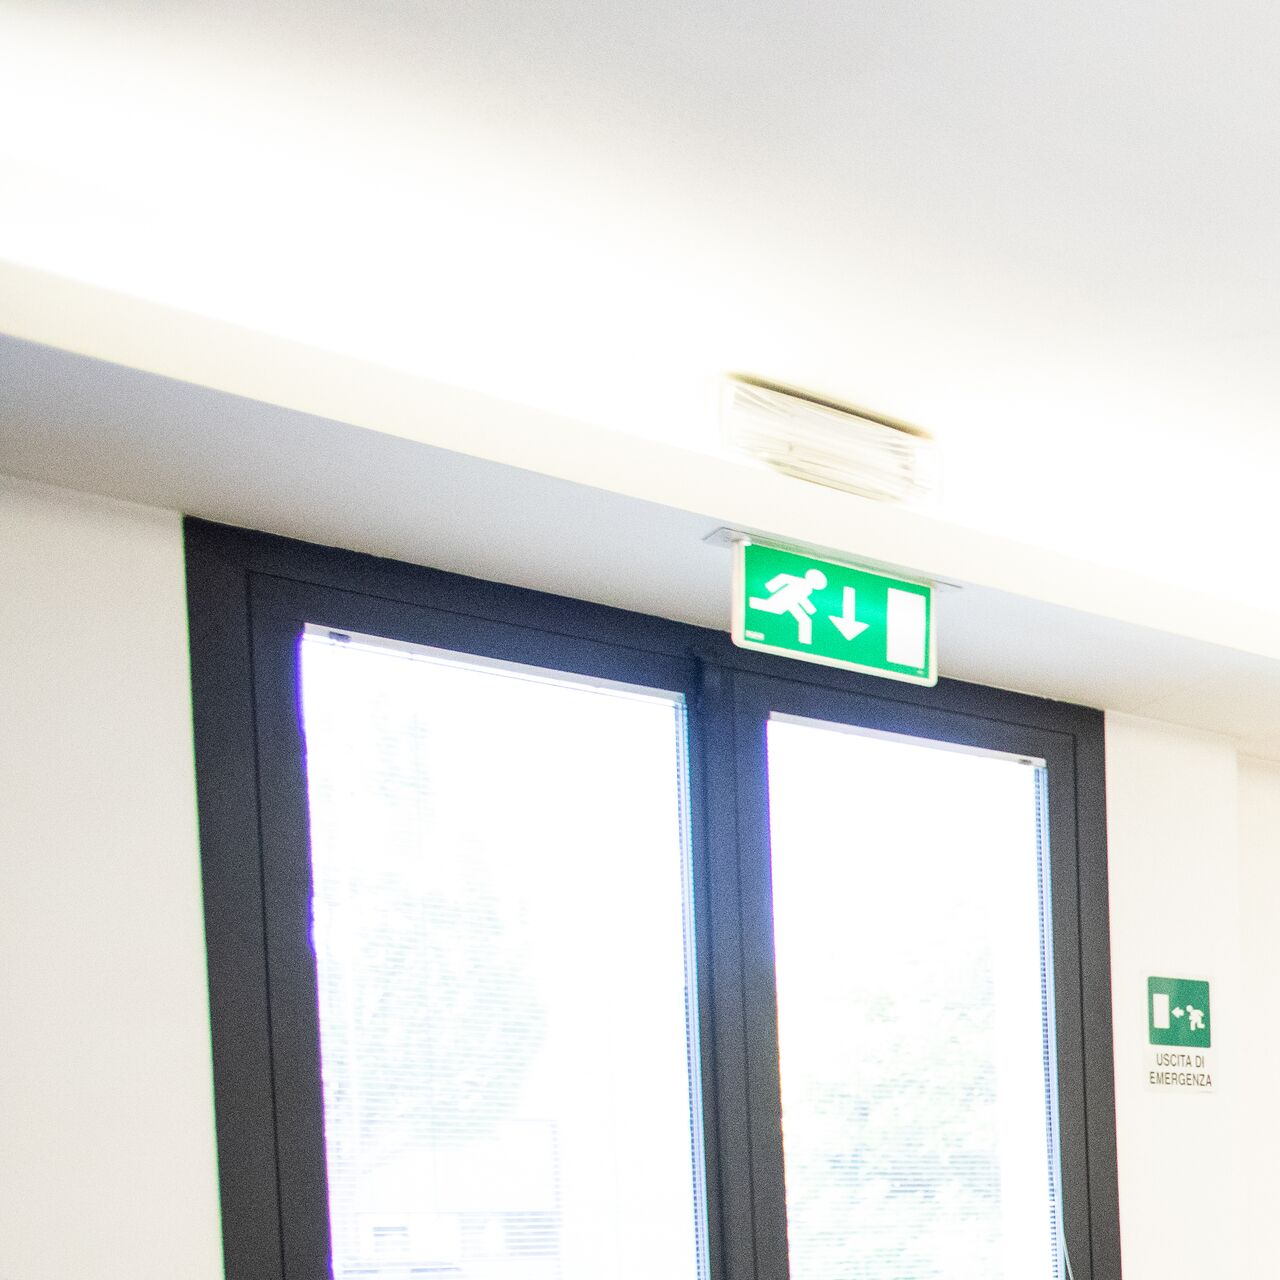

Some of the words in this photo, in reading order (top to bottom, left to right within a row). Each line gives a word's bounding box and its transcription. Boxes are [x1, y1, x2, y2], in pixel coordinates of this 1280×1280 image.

[1156, 1053, 1192, 1068] USCITA
[1195, 1055, 1205, 1068] DI
[1149, 1071, 1212, 1087] EMERGENZA
